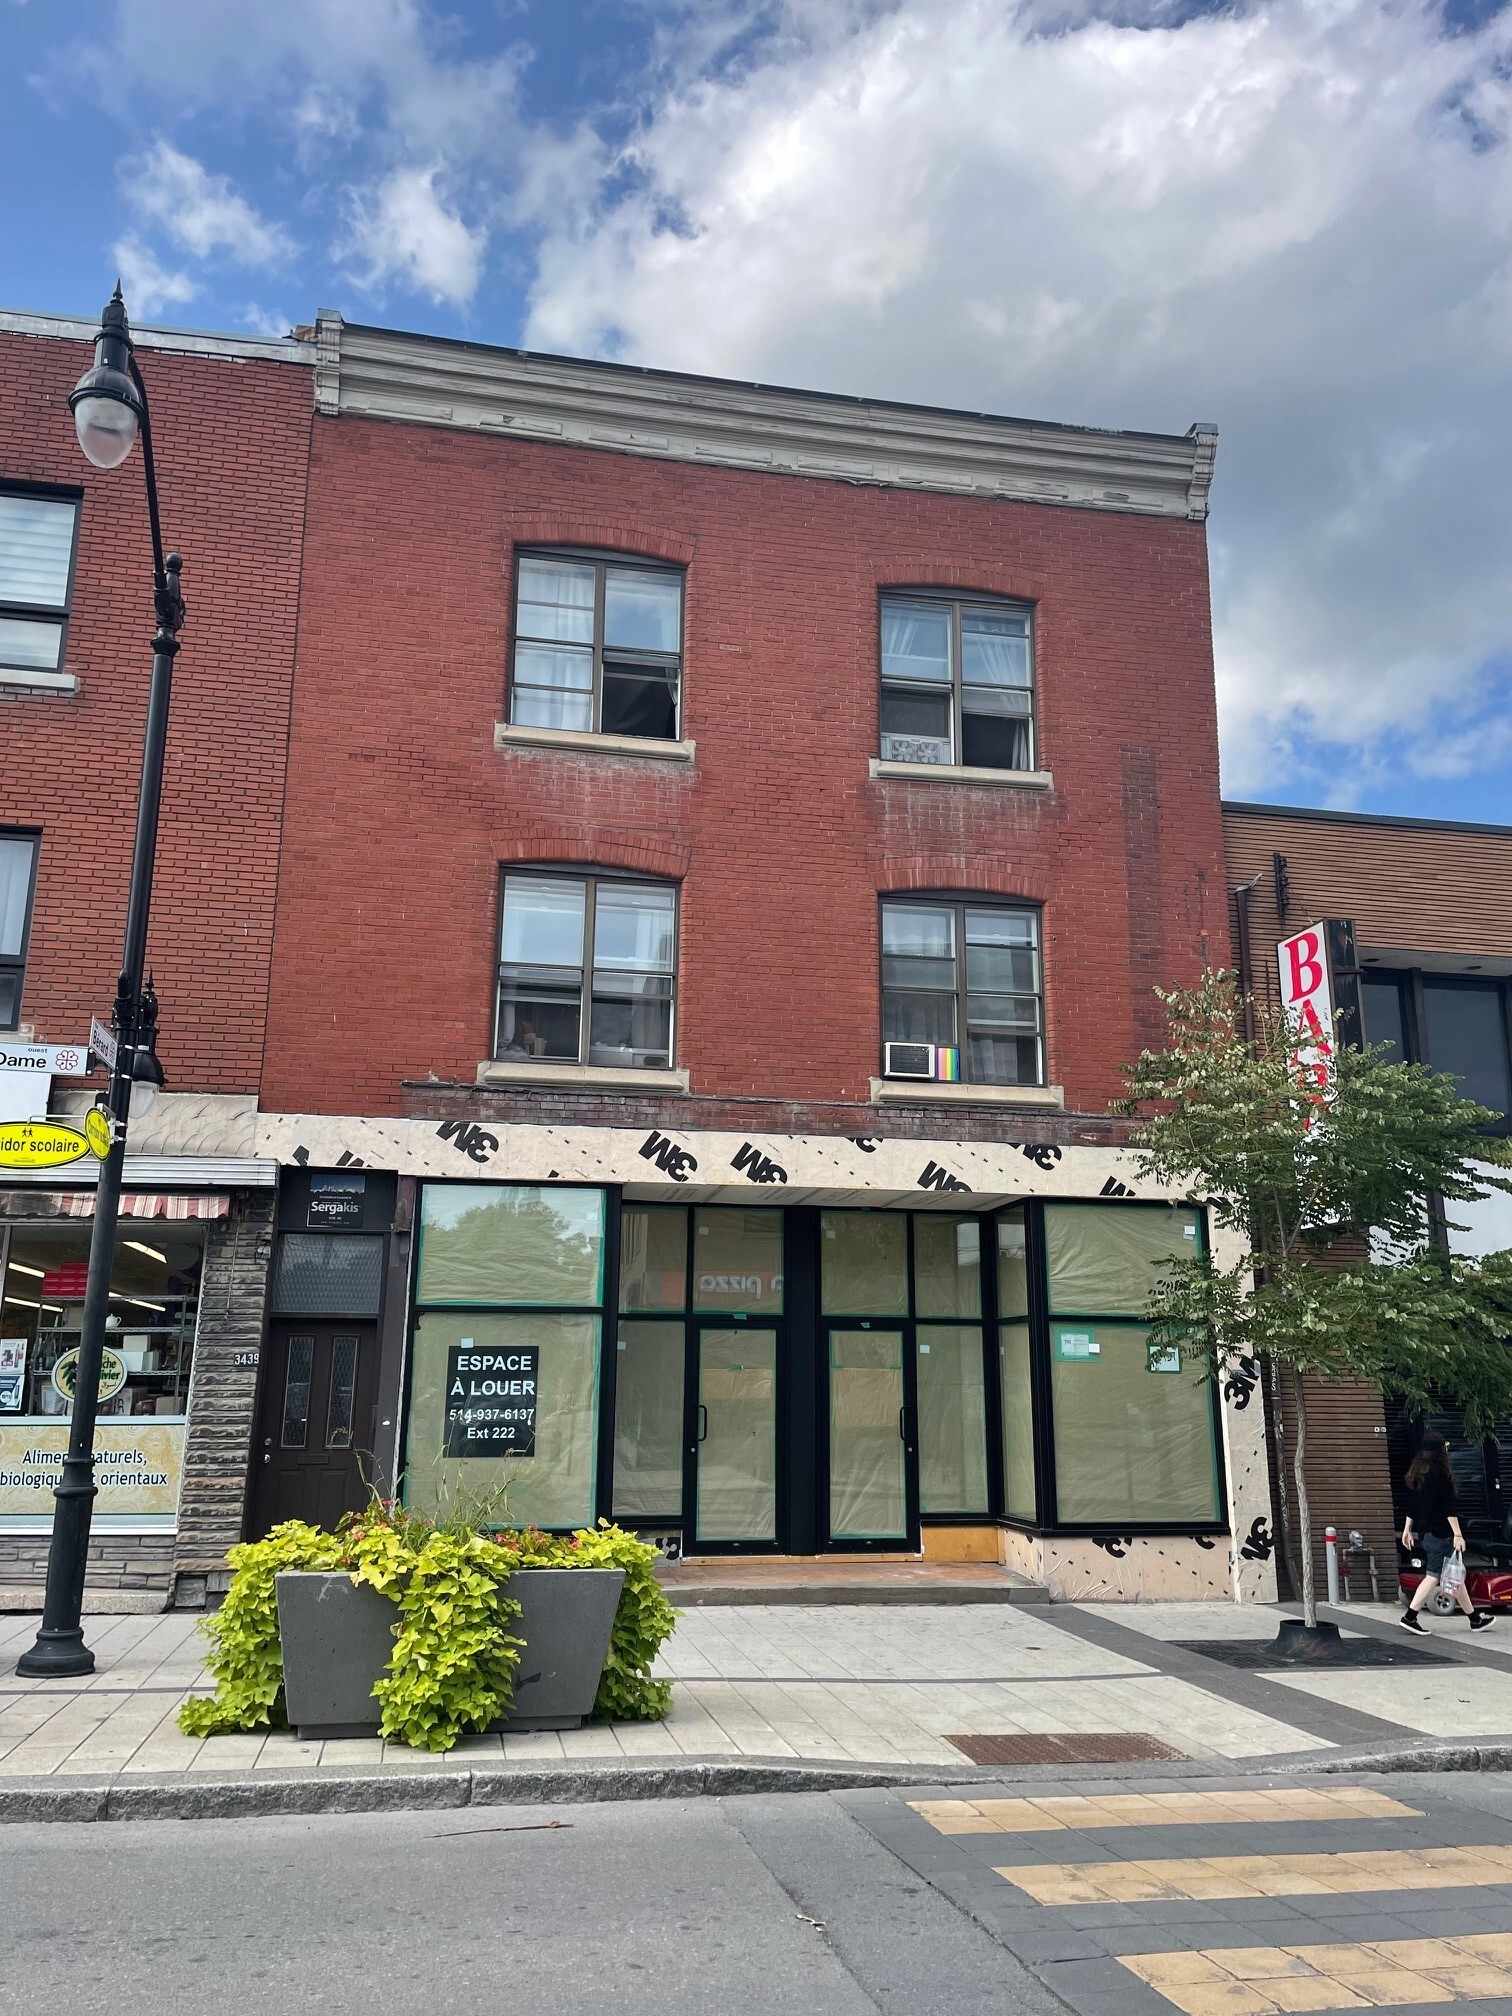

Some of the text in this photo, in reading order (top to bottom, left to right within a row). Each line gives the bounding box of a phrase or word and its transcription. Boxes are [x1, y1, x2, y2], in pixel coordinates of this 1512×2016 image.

[0, 1137, 79, 1153] idor scolaire
[435, 1120, 499, 1163] 3M
[638, 1130, 698, 1182] 3M
[730, 1141, 788, 1184] 3M
[311, 1201, 359, 1215] Sergakis
[101, 1357, 116, 1369] che
[234, 1353, 260, 1366] 3439
[457, 1355, 532, 1371] ESPACE
[101, 1370, 121, 1380] ivier
[1224, 1355, 1260, 1410] 3M
[450, 1377, 535, 1396] À LOUER
[449, 1408, 535, 1421] 514-937-6137
[467, 1427, 516, 1439] Ext 222
[22, 1450, 69, 1465] Alimen
[0, 1471, 63, 1489] biologiqu
[100, 1471, 168, 1486] orientaux
